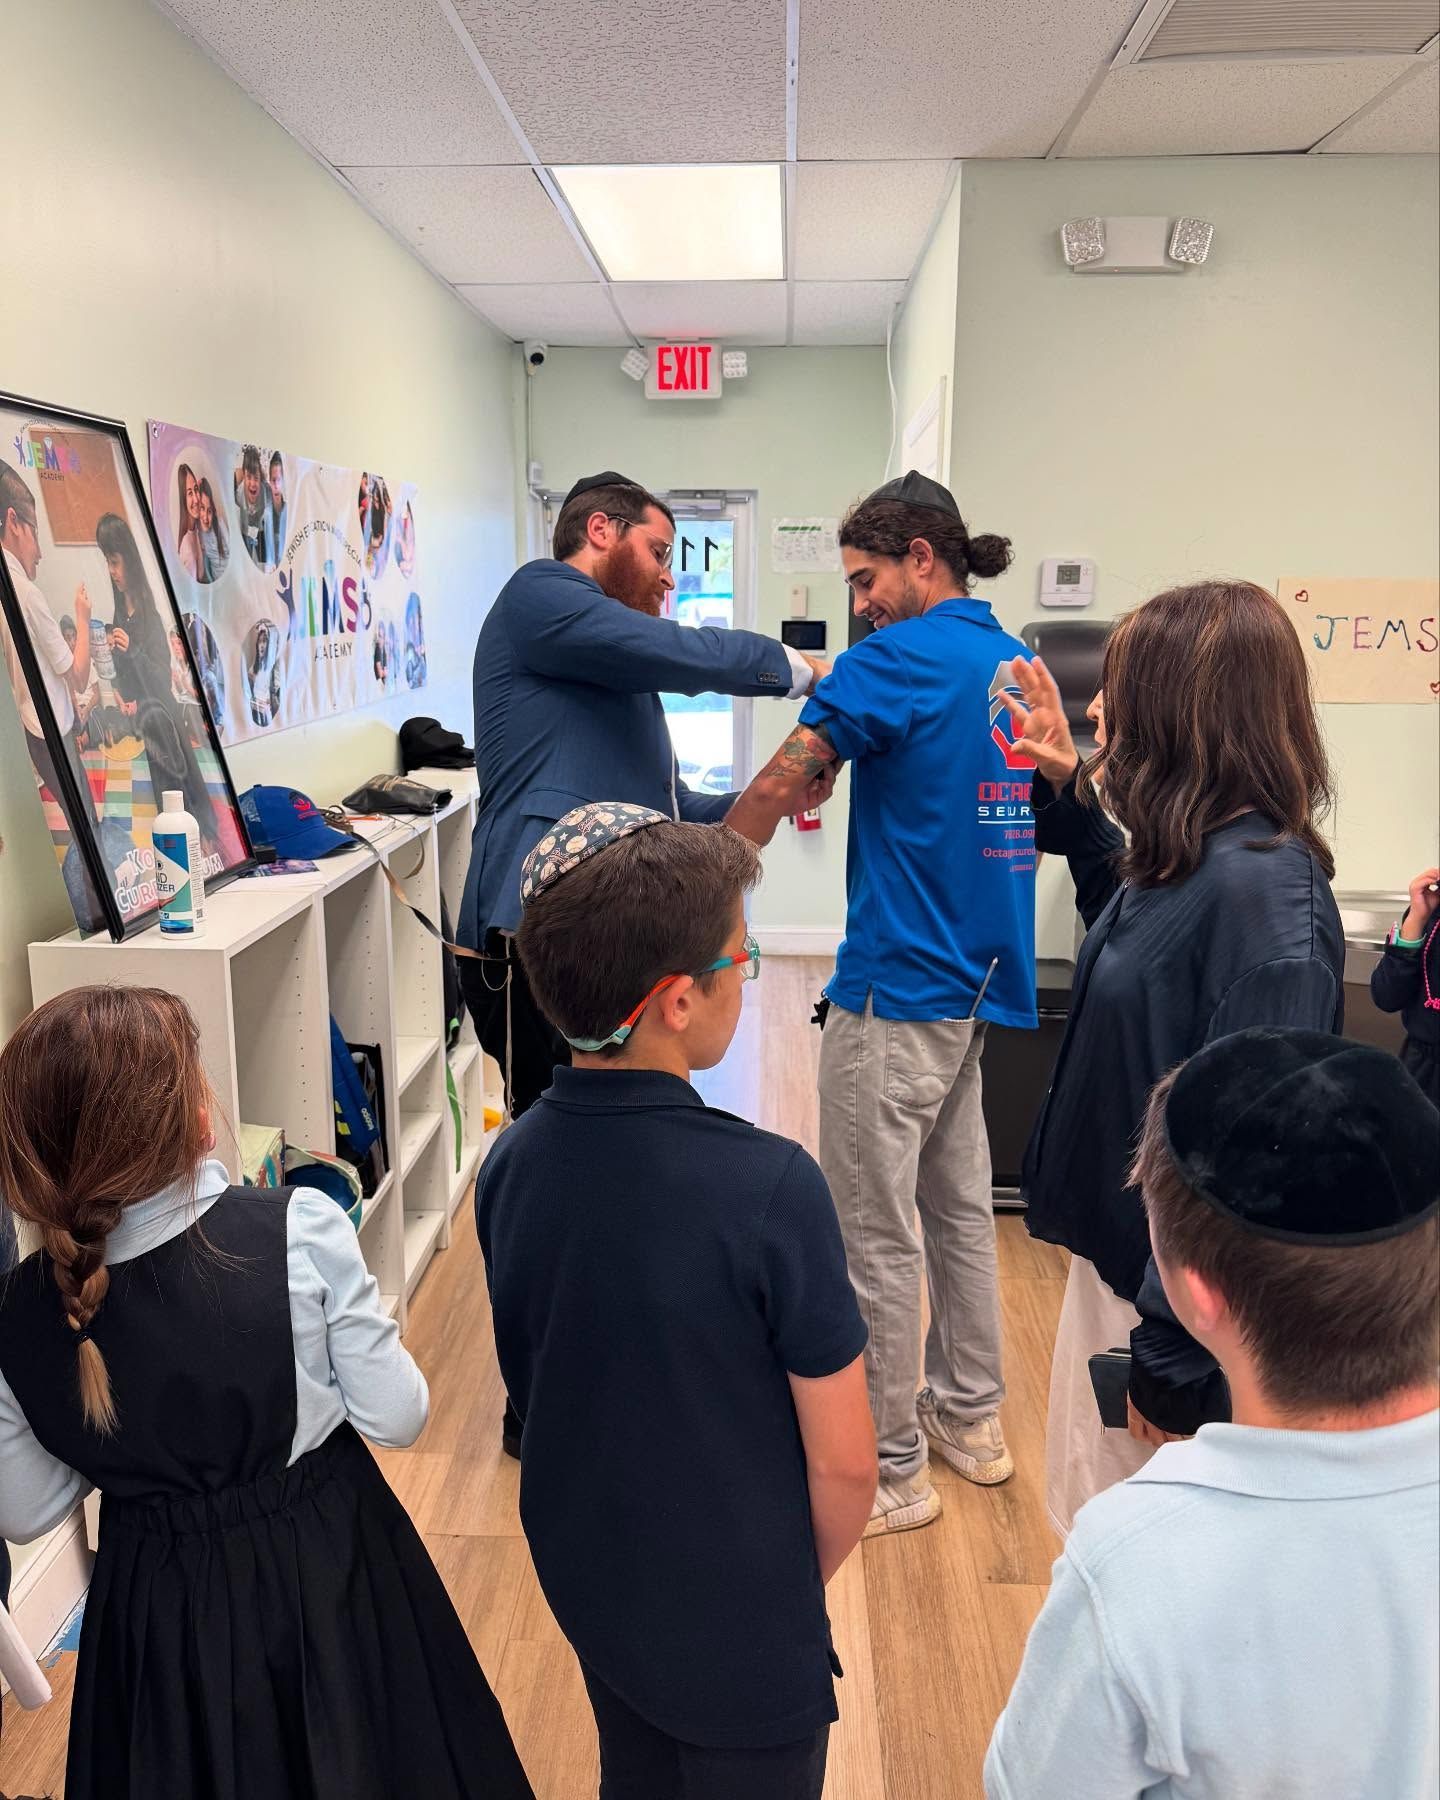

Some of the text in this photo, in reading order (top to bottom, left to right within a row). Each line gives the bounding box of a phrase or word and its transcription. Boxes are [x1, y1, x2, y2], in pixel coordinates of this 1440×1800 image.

[657, 345, 712, 391] EXIT
[298, 576, 360, 638] JEMS
[314, 642, 353, 662] AADEMY
[1313, 614, 1438, 652] JEMS
